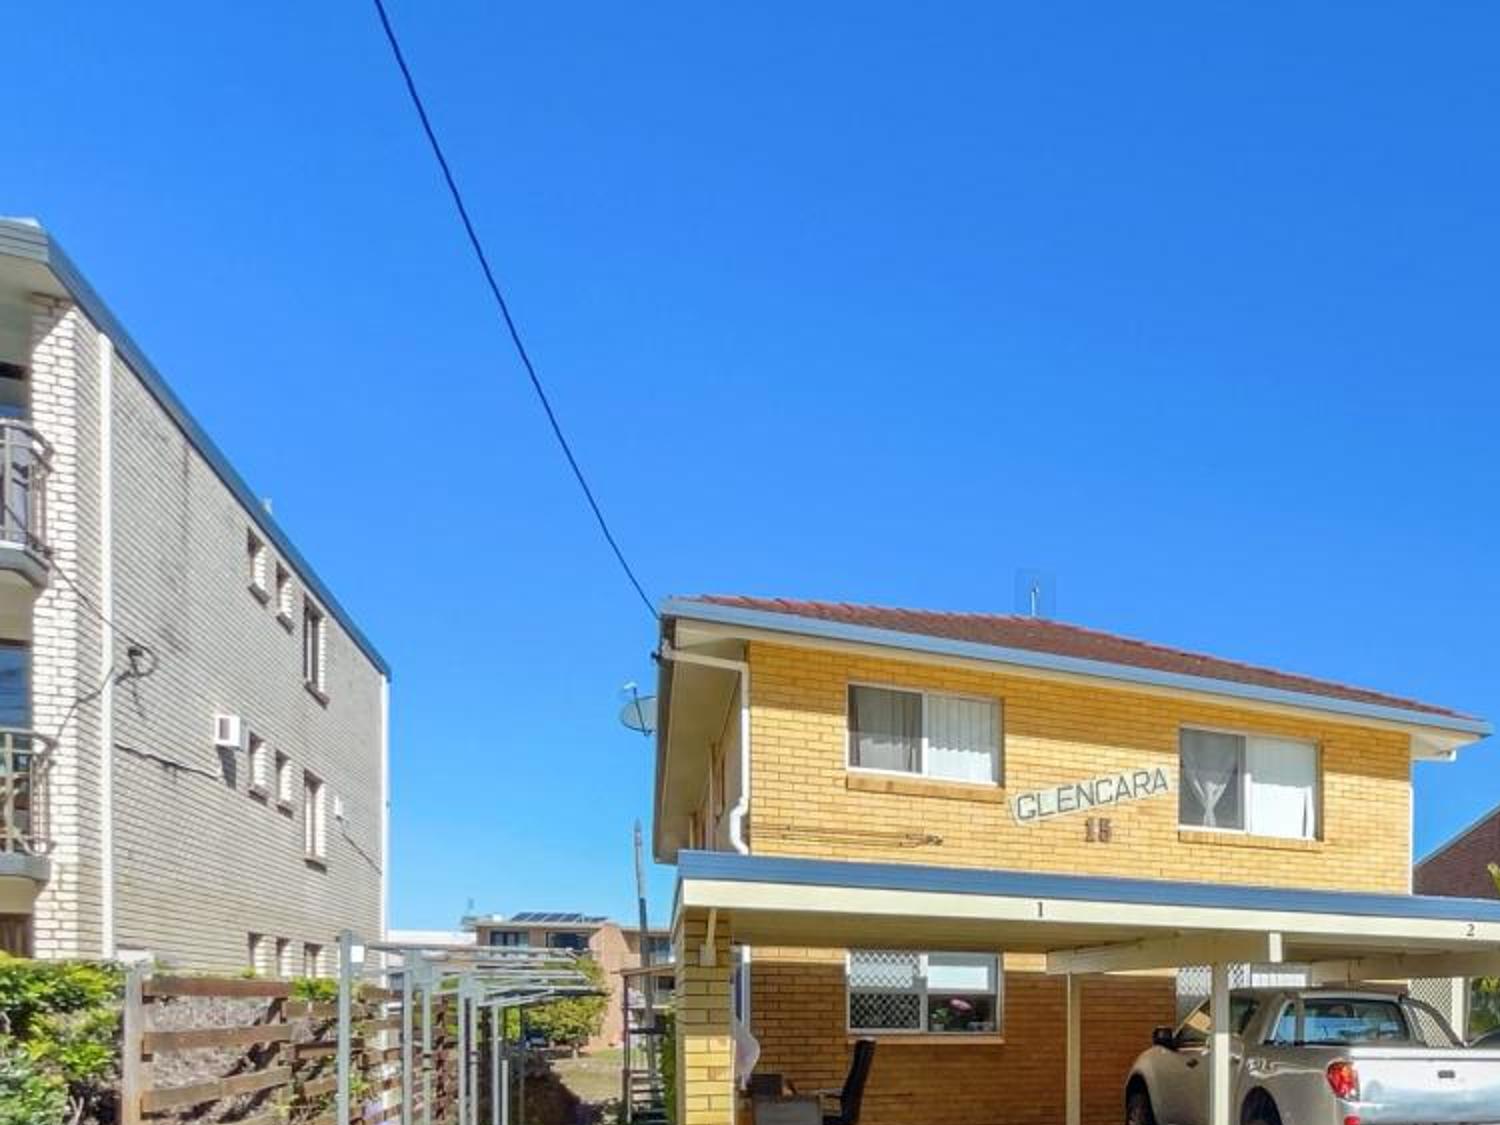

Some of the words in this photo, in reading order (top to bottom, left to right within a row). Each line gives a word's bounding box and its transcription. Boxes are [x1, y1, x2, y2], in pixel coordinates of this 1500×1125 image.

[1017, 768, 1169, 821] GLENCARA
[1085, 817, 1112, 843] 15
[1036, 901, 1044, 918] 1
[1465, 923, 1476, 937] 2
